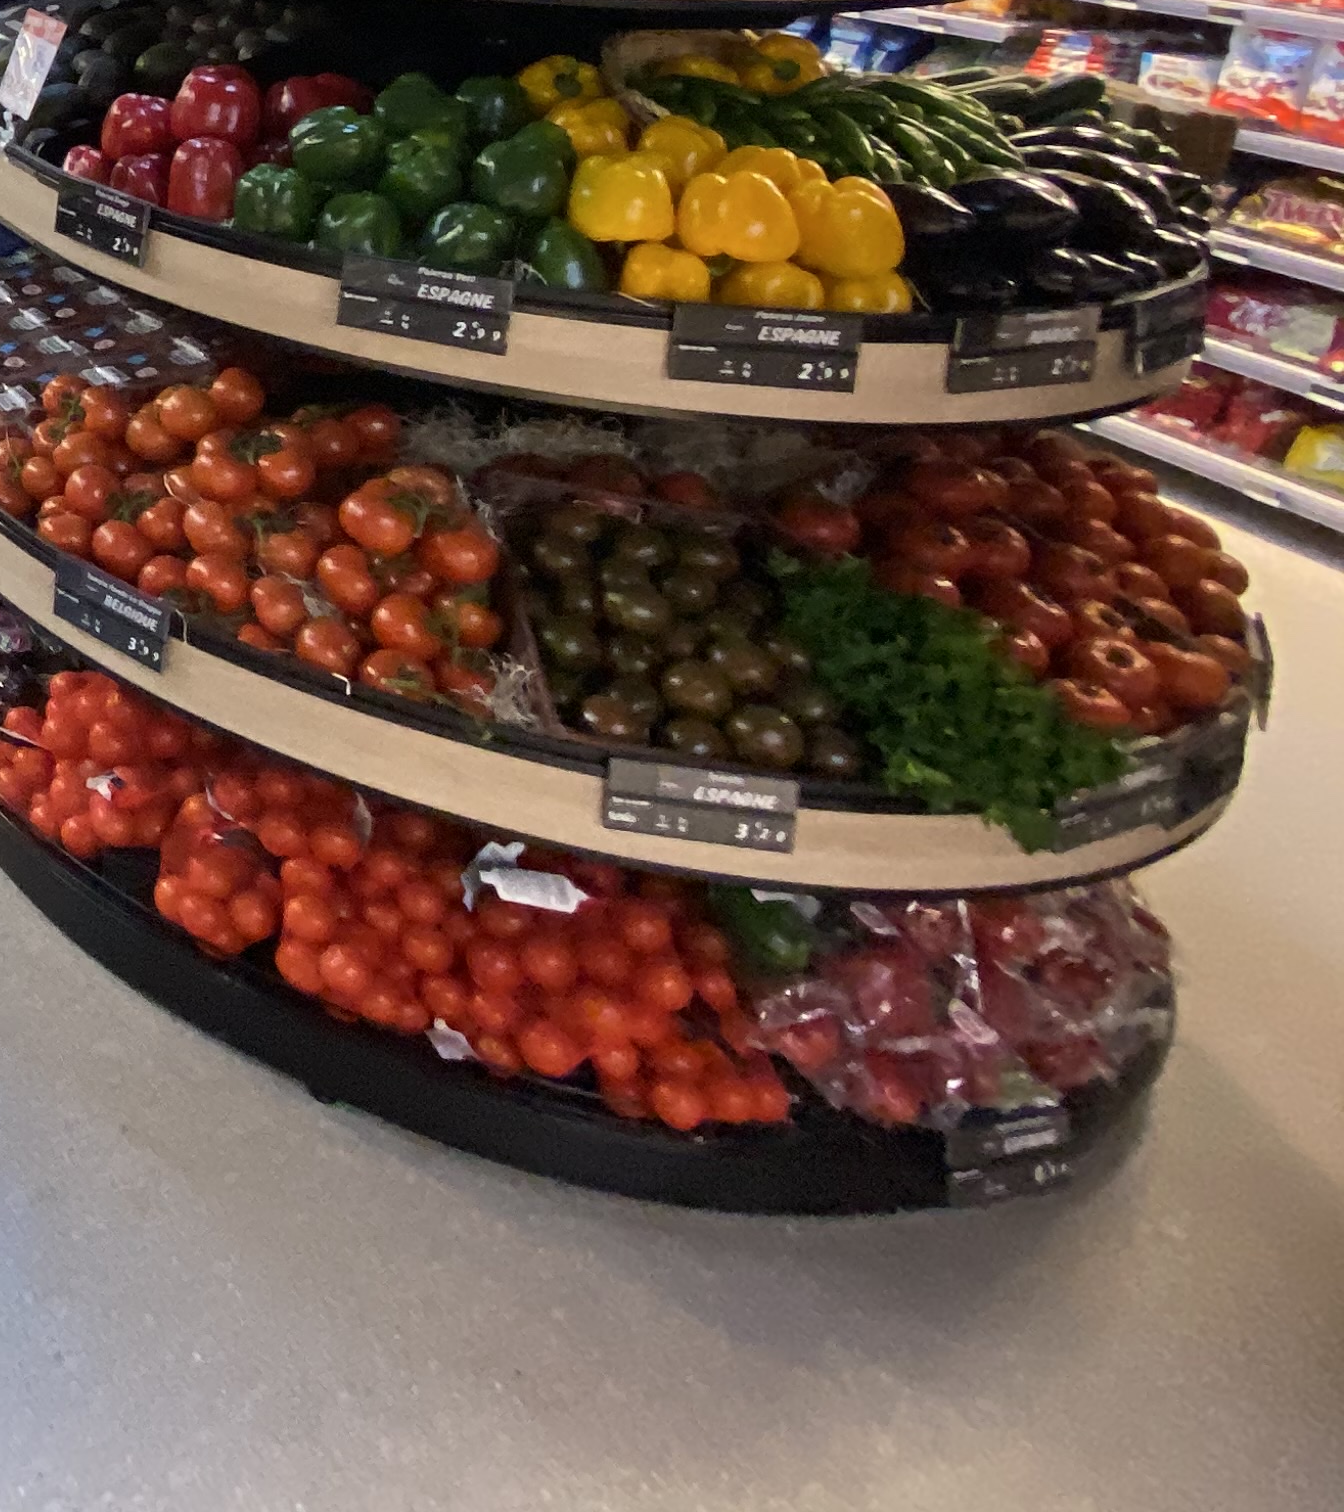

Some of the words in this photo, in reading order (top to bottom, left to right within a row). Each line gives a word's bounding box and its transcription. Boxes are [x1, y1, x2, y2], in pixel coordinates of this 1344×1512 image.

[416, 283, 495, 310] ESPAGNE
[757, 325, 842, 346] ESPAGNE
[103, 594, 159, 633] BELGIQUE
